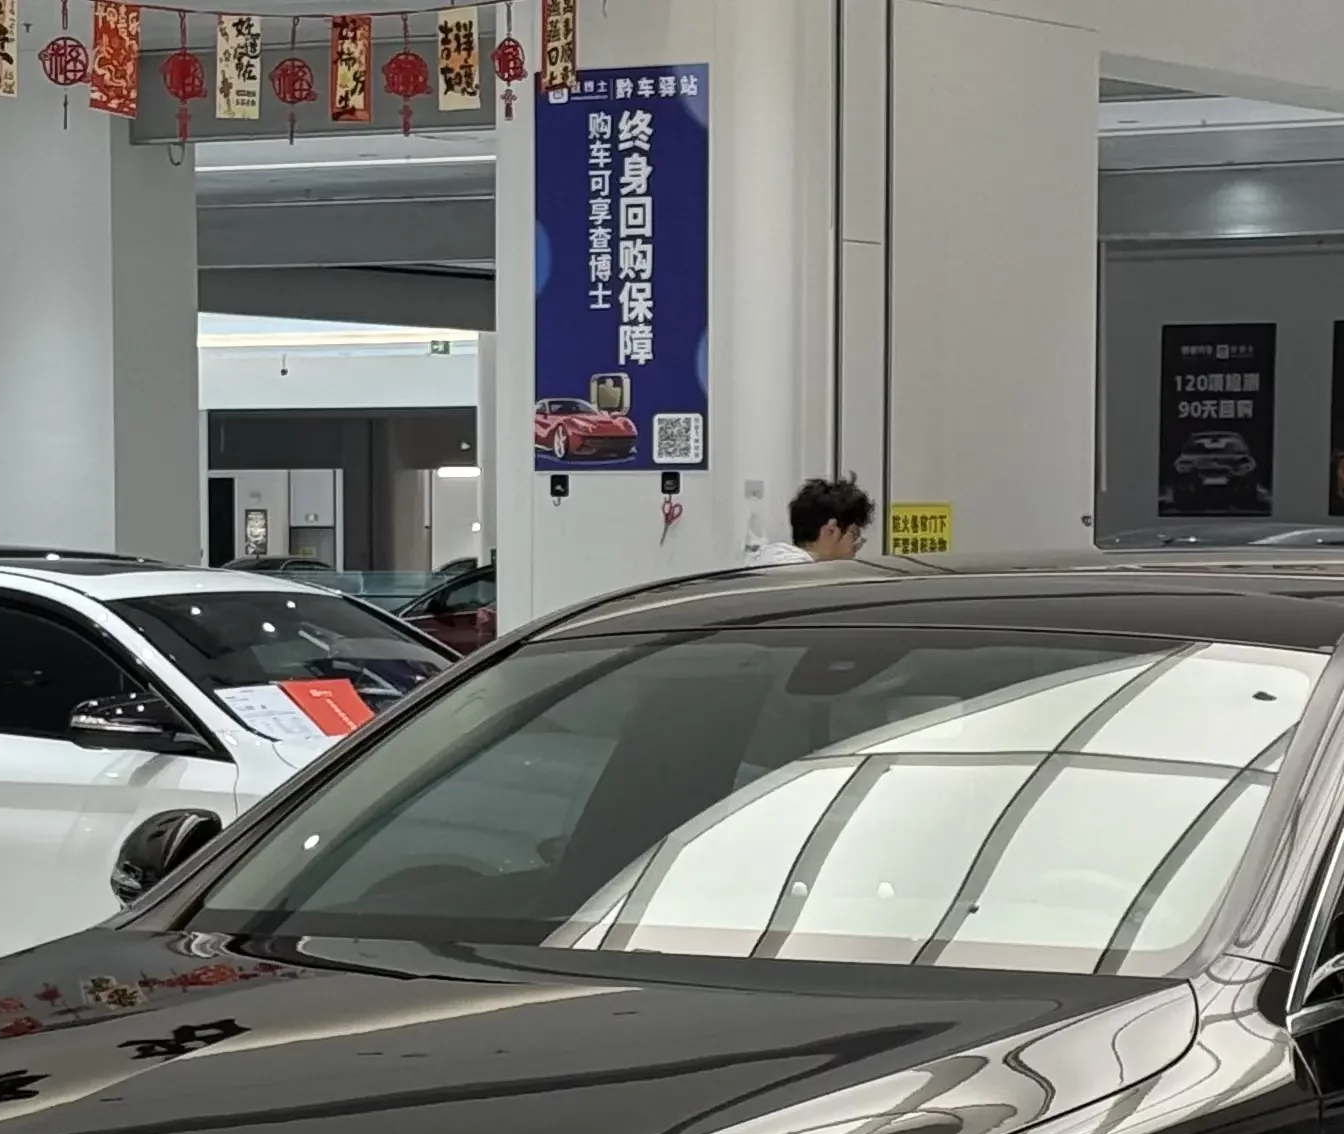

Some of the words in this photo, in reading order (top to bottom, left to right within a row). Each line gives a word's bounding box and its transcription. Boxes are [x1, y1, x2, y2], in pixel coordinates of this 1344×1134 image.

[615, 74, 700, 100] 黔车驿站
[587, 112, 613, 310] 购车可享查博士
[617, 109, 654, 366] 终身回购保障
